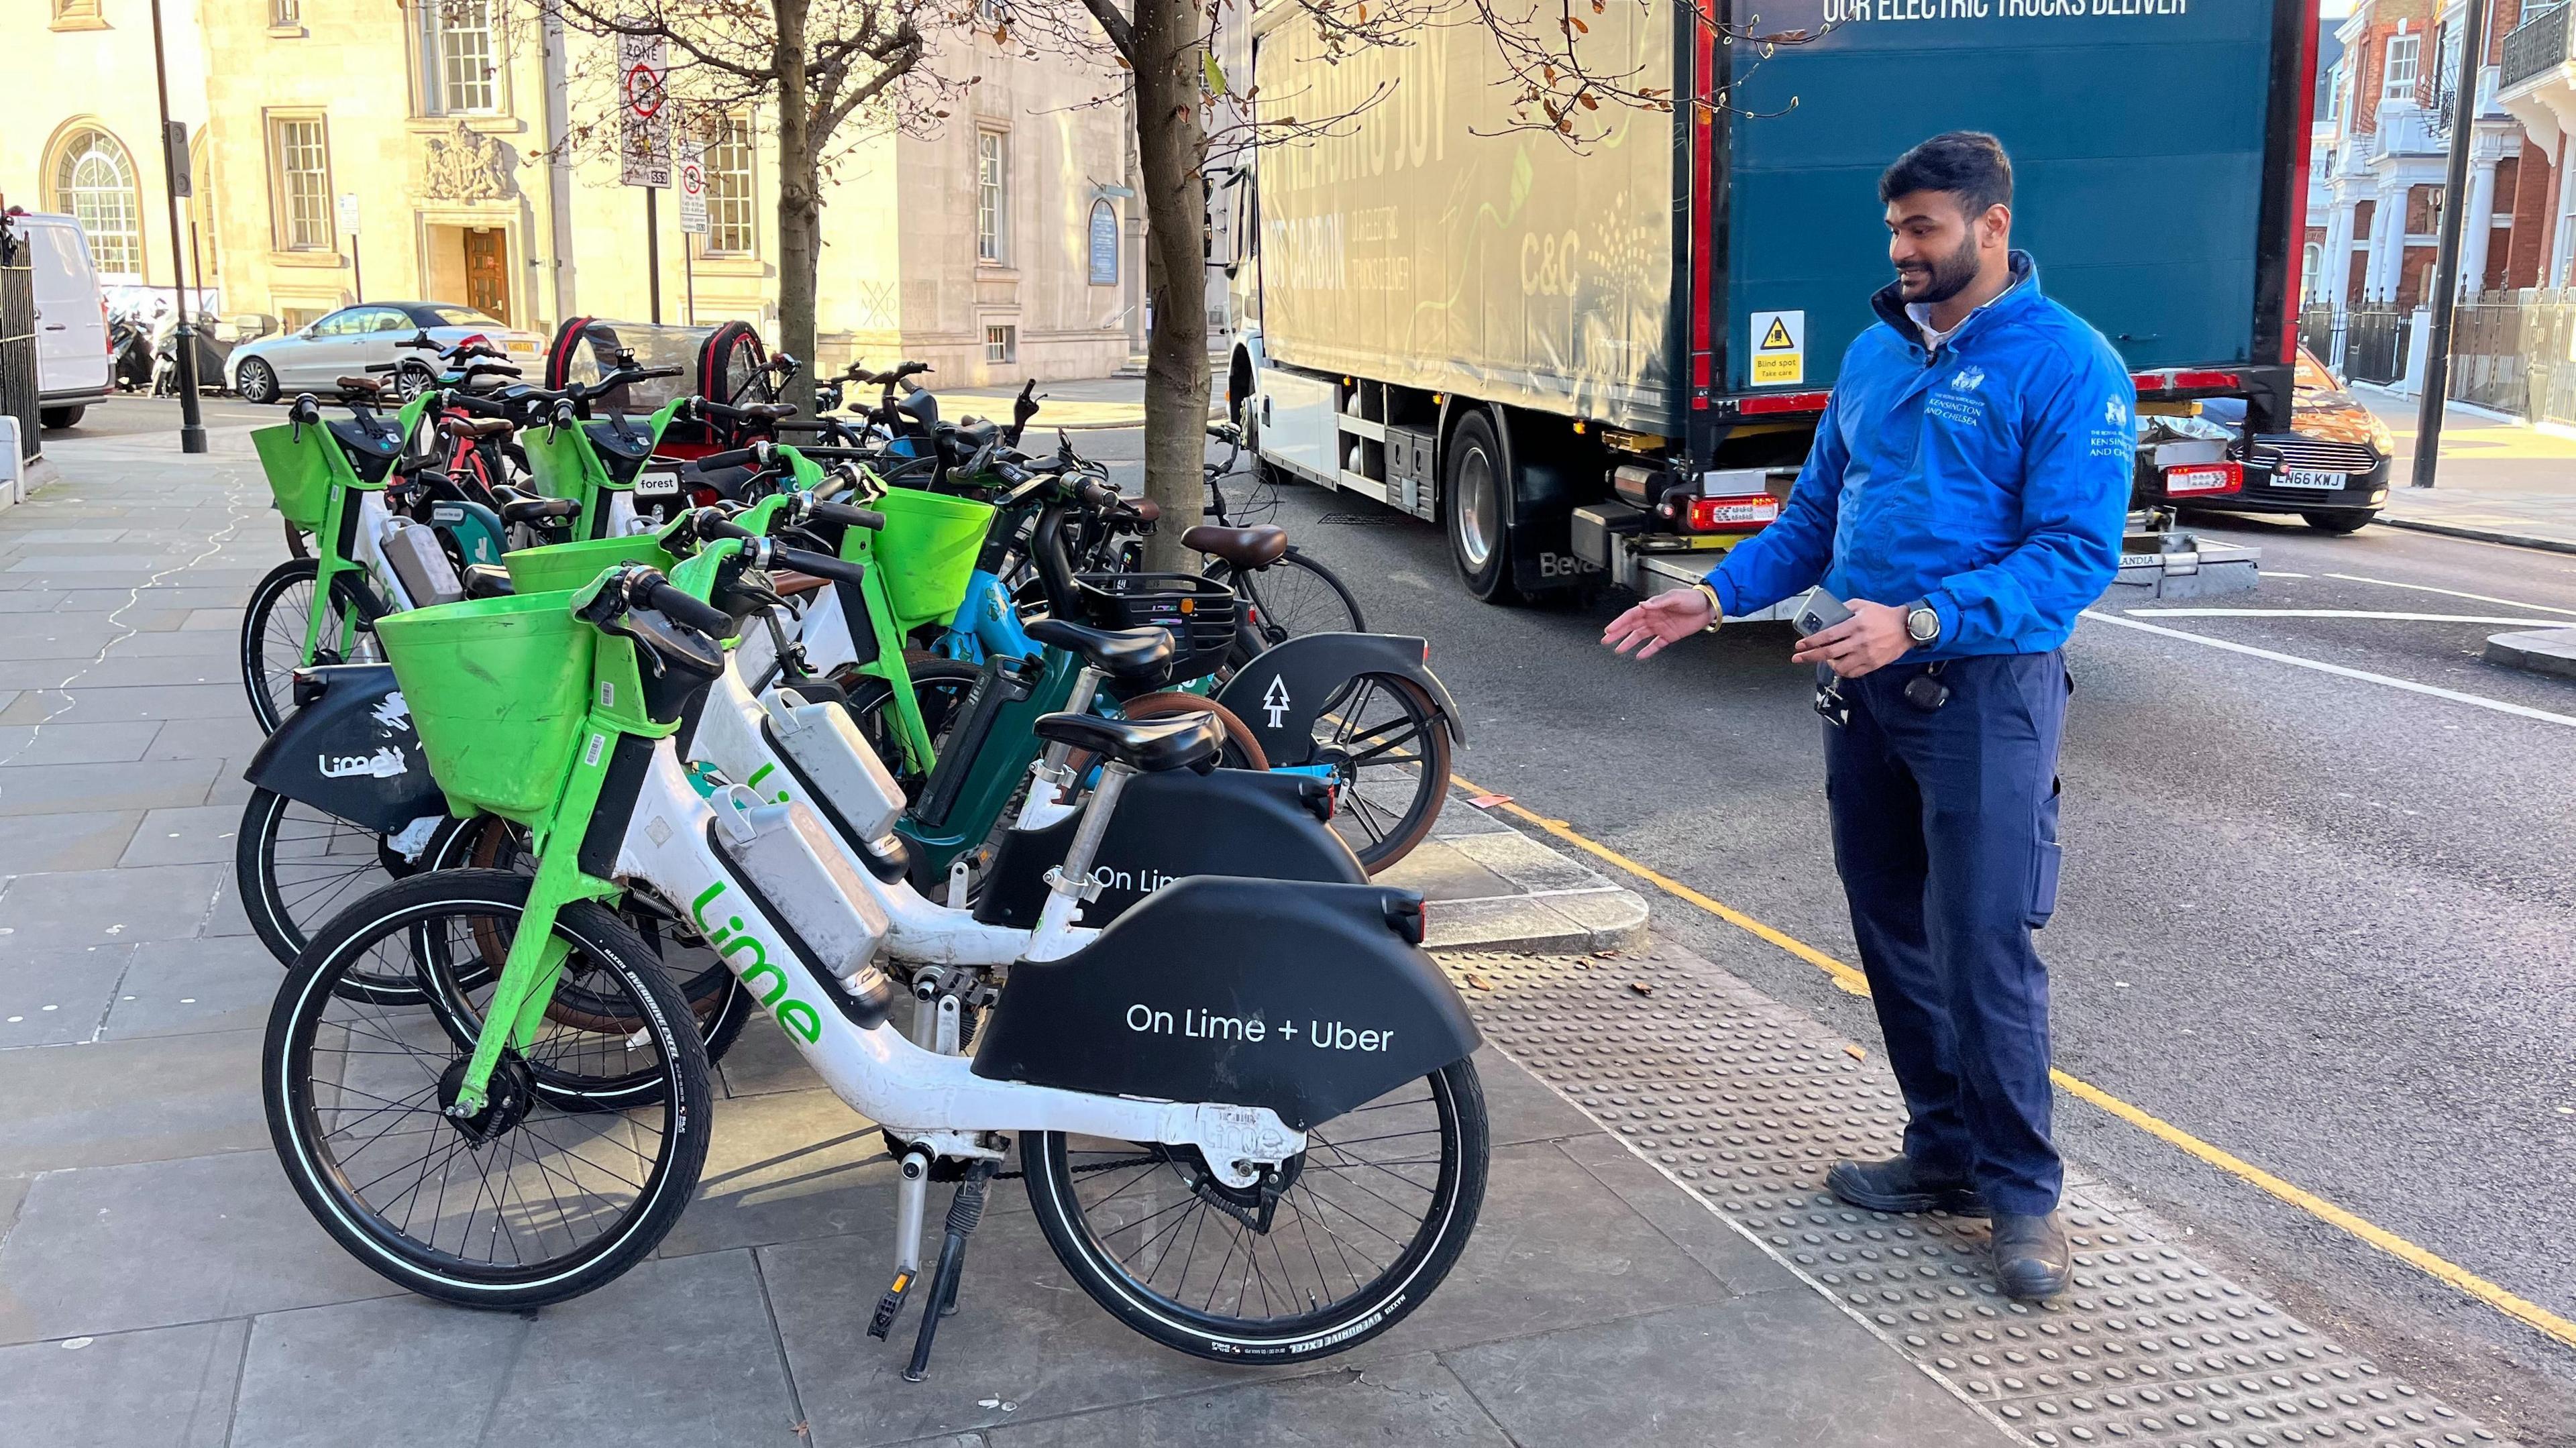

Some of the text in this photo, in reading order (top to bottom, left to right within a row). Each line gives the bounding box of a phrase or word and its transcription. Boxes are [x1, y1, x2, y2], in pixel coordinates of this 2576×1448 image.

[627, 44, 657, 61] ZONE
[652, 172, 667, 183] SS3
[1289, 213, 1346, 290] CARBON
[1521, 229, 1580, 297] C&C
[1779, 359, 1797, 368] spot
[1924, 407, 1977, 427] AND CHELSEA
[1929, 398, 1982, 416] KENSINGTON
[2090, 448, 2112, 456] AND
[641, 478, 674, 488] forest
[2314, 474, 2340, 486] KWJ
[1095, 866, 1131, 890] On
[604, 949, 627, 969] MAXXIS
[692, 879, 821, 1045] Lime
[627, 971, 680, 1060] OVERDRIVE EXCEL
[1126, 1003, 1394, 1052] On Lime + Uber
[1384, 1294, 1406, 1316] MAXXIS
[1289, 1312, 1383, 1354] OVERDRIVE EXCEL
